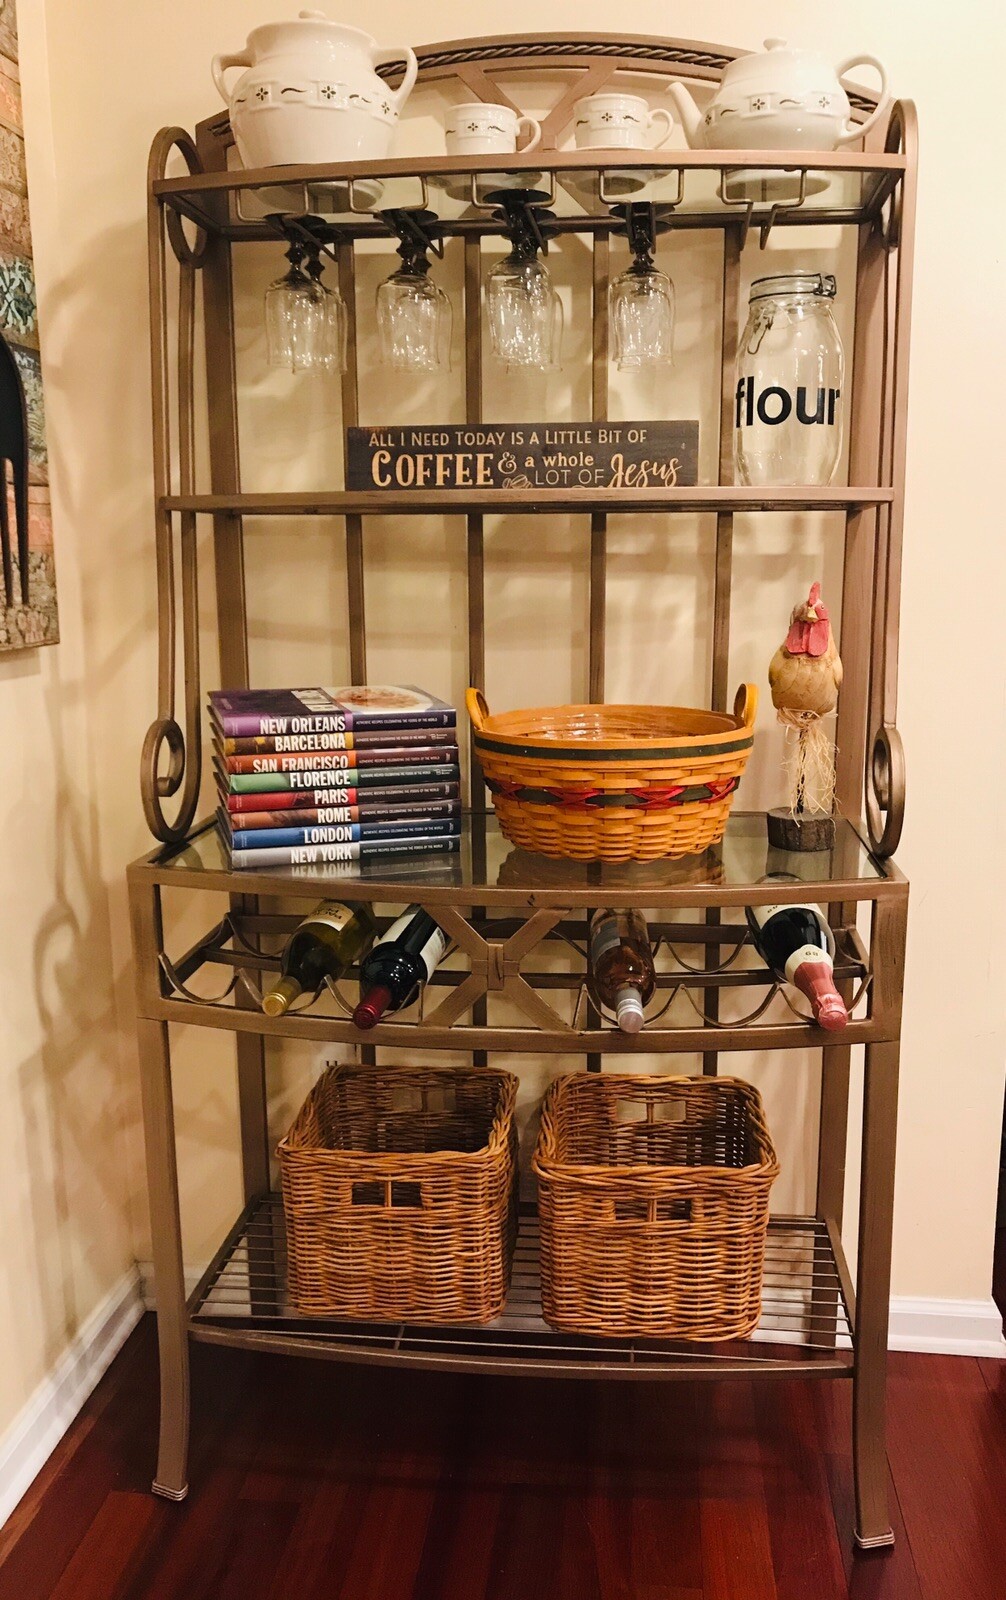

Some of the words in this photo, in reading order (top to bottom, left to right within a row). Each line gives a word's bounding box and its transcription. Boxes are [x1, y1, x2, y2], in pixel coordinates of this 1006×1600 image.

[736, 376, 840, 428] flour
[369, 433, 395, 447] ALL
[400, 433, 405, 446] I
[412, 433, 449, 446] NEED
[455, 431, 505, 446] TODAY
[511, 432, 524, 445] IS
[529, 432, 540, 445] A
[546, 430, 592, 444] LITTLE
[598, 429, 622, 444] BIT
[627, 429, 648, 443] OF
[371, 450, 494, 487] COFFEE
[497, 451, 517, 474] &
[524, 455, 535, 467] a
[542, 452, 594, 467] whole
[535, 469, 571, 485] LOT
[578, 469, 604, 484] OF
[608, 453, 683, 488] Jesus
[260, 718, 287, 735] NEW
[291, 716, 346, 734] ORLEANS
[274, 733, 346, 752] BARCELONA
[253, 758, 278, 773] SAN
[281, 755, 349, 772] FRANCISCO
[289, 770, 351, 788] FLORENCE
[314, 788, 349, 805] PARIS
[317, 807, 352, 824] ROME
[304, 826, 352, 844] LONDON
[290, 848, 317, 864] NEW
[321, 845, 352, 862] YORK
